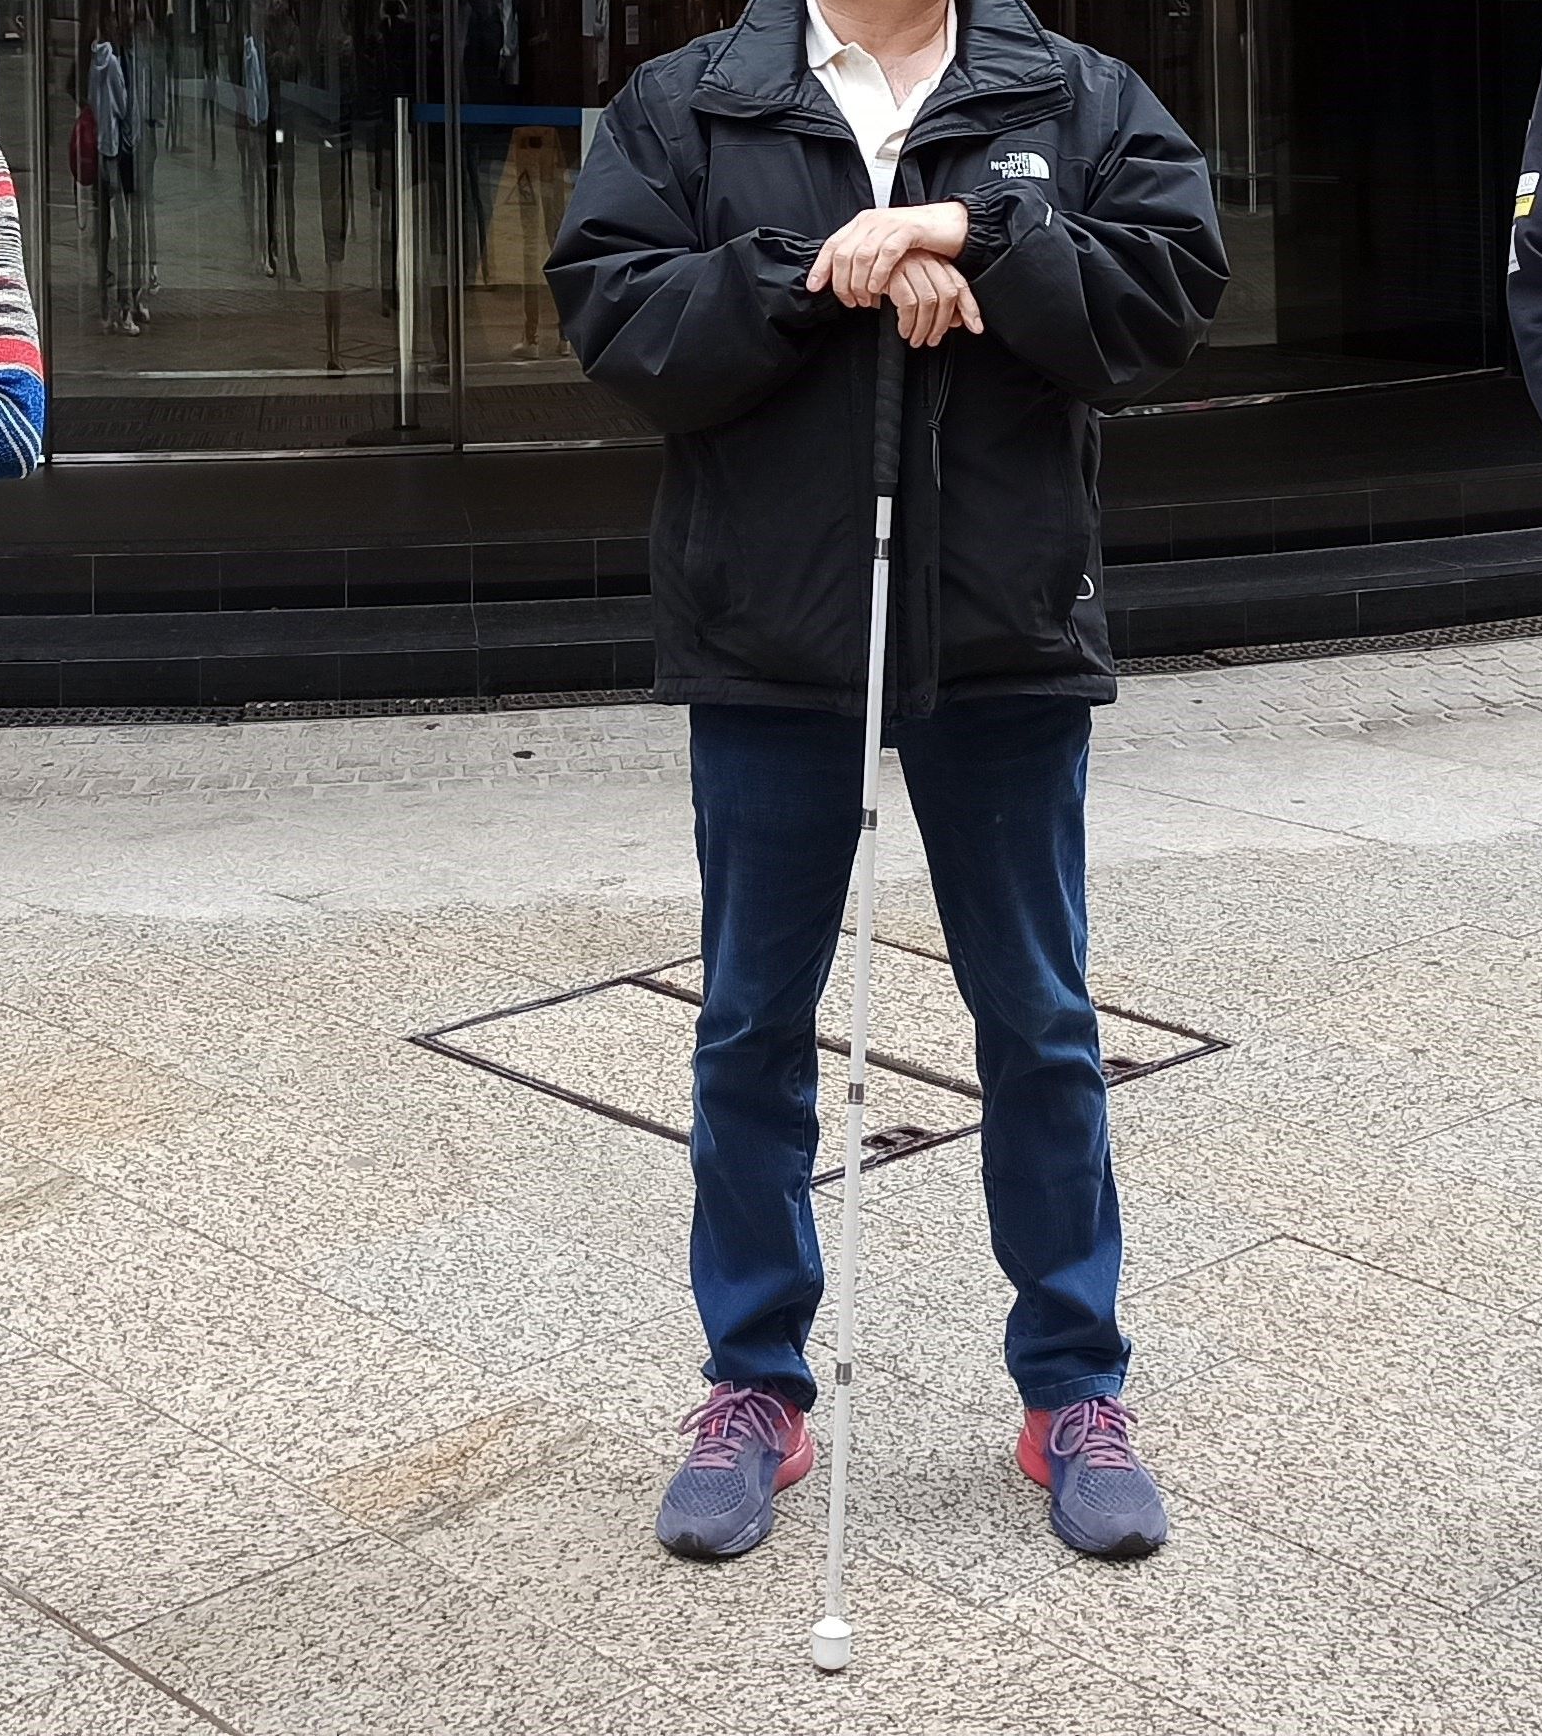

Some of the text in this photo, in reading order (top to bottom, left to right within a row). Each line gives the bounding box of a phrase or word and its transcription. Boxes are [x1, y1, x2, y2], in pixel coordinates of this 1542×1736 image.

[1005, 152, 1029, 161] THE
[990, 160, 1030, 170] NORTH
[1001, 169, 1030, 179] FACE
